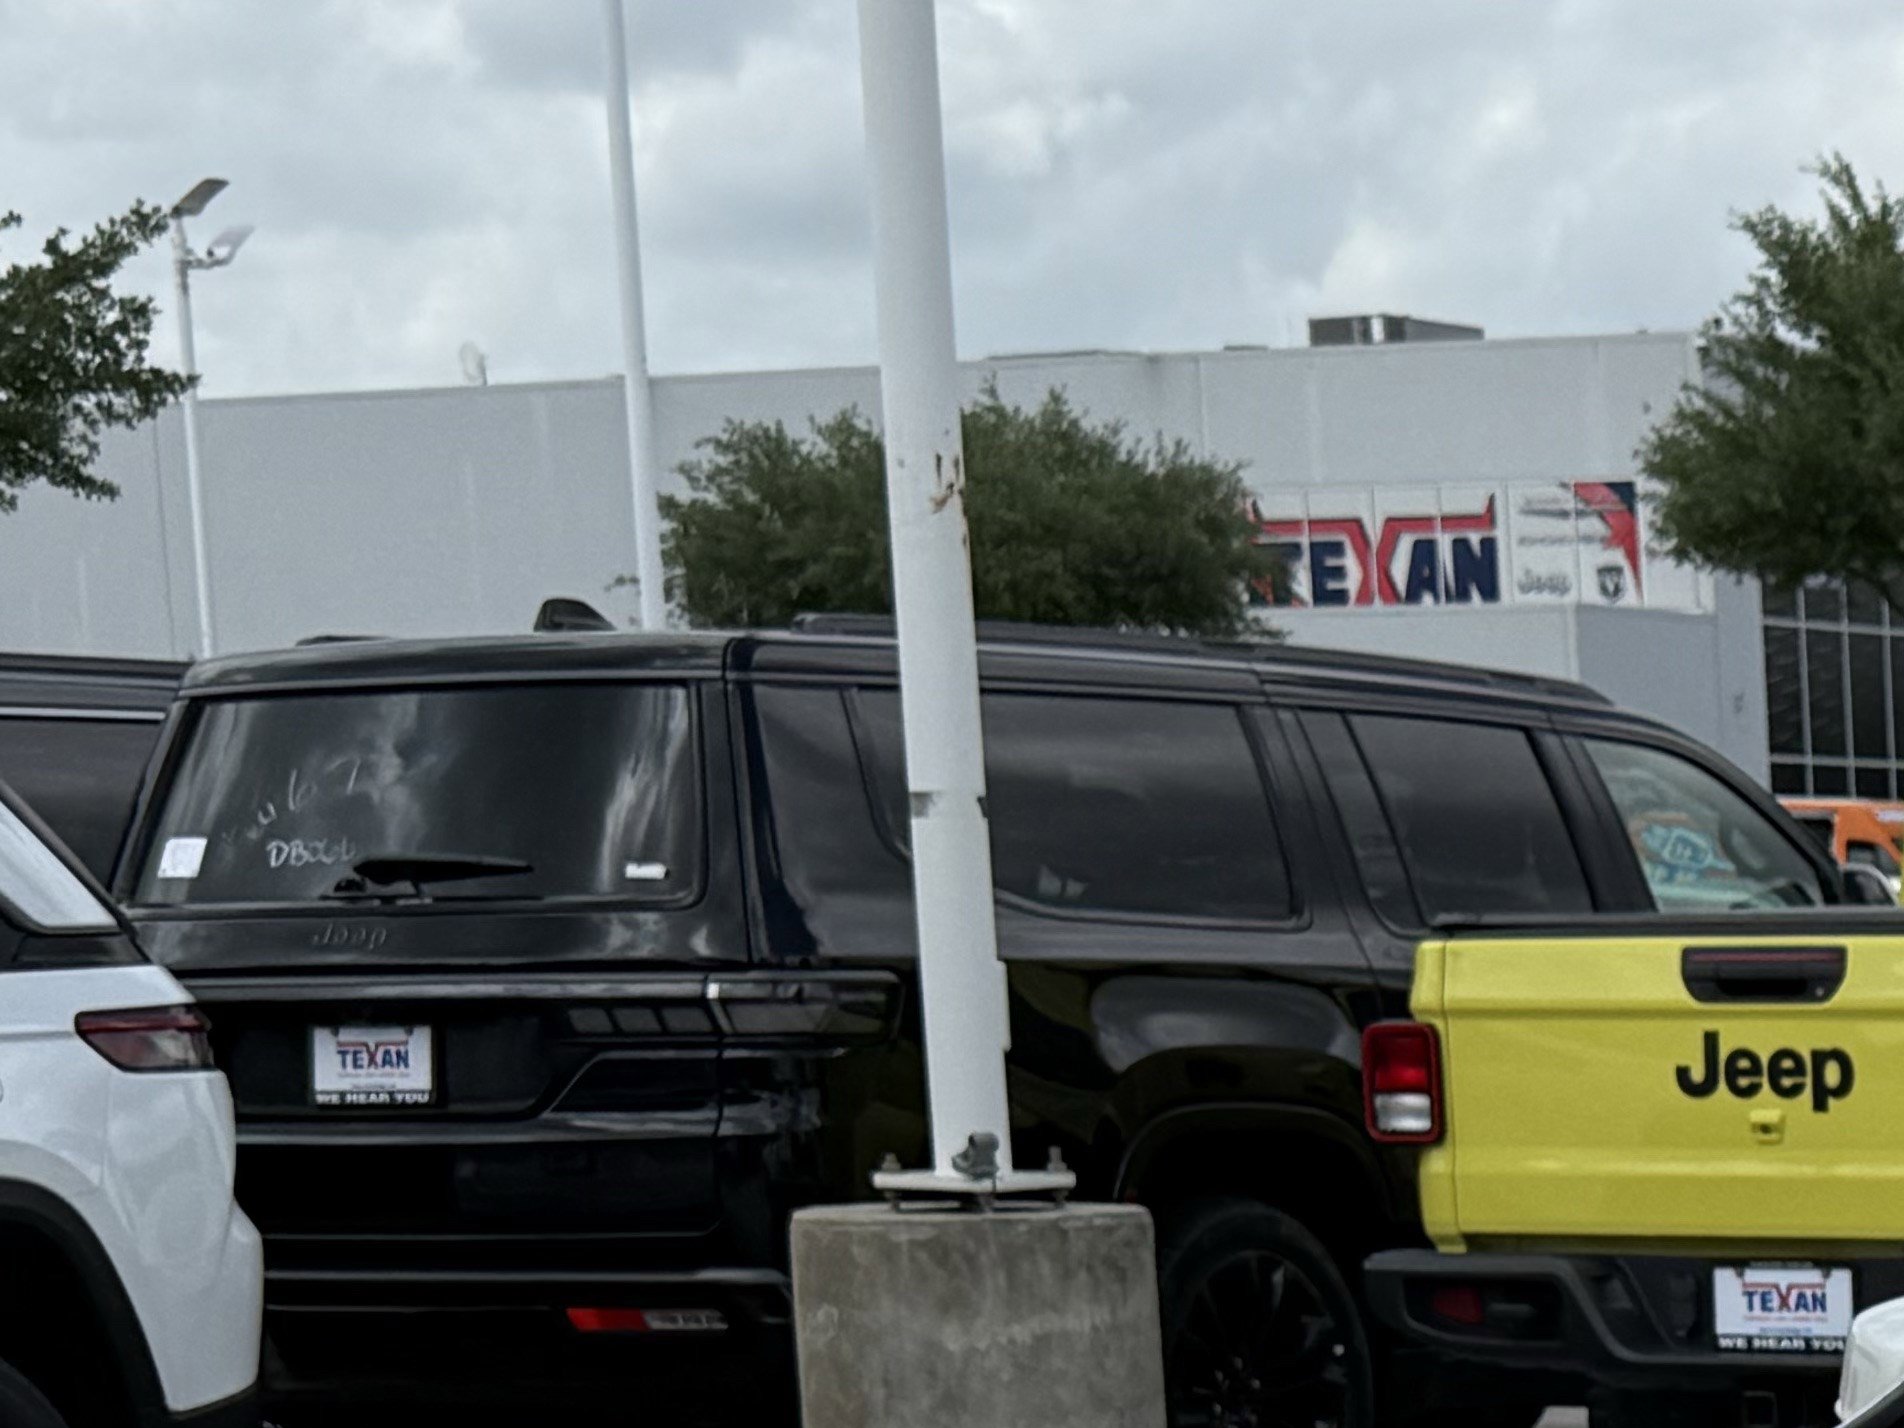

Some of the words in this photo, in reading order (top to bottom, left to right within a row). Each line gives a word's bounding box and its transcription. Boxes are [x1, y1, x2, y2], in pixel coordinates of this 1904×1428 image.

[336, 1040, 410, 1070] TEXAN
[1675, 1030, 1855, 1113] Jeep
[1743, 1282, 1828, 1313] TEXAN
